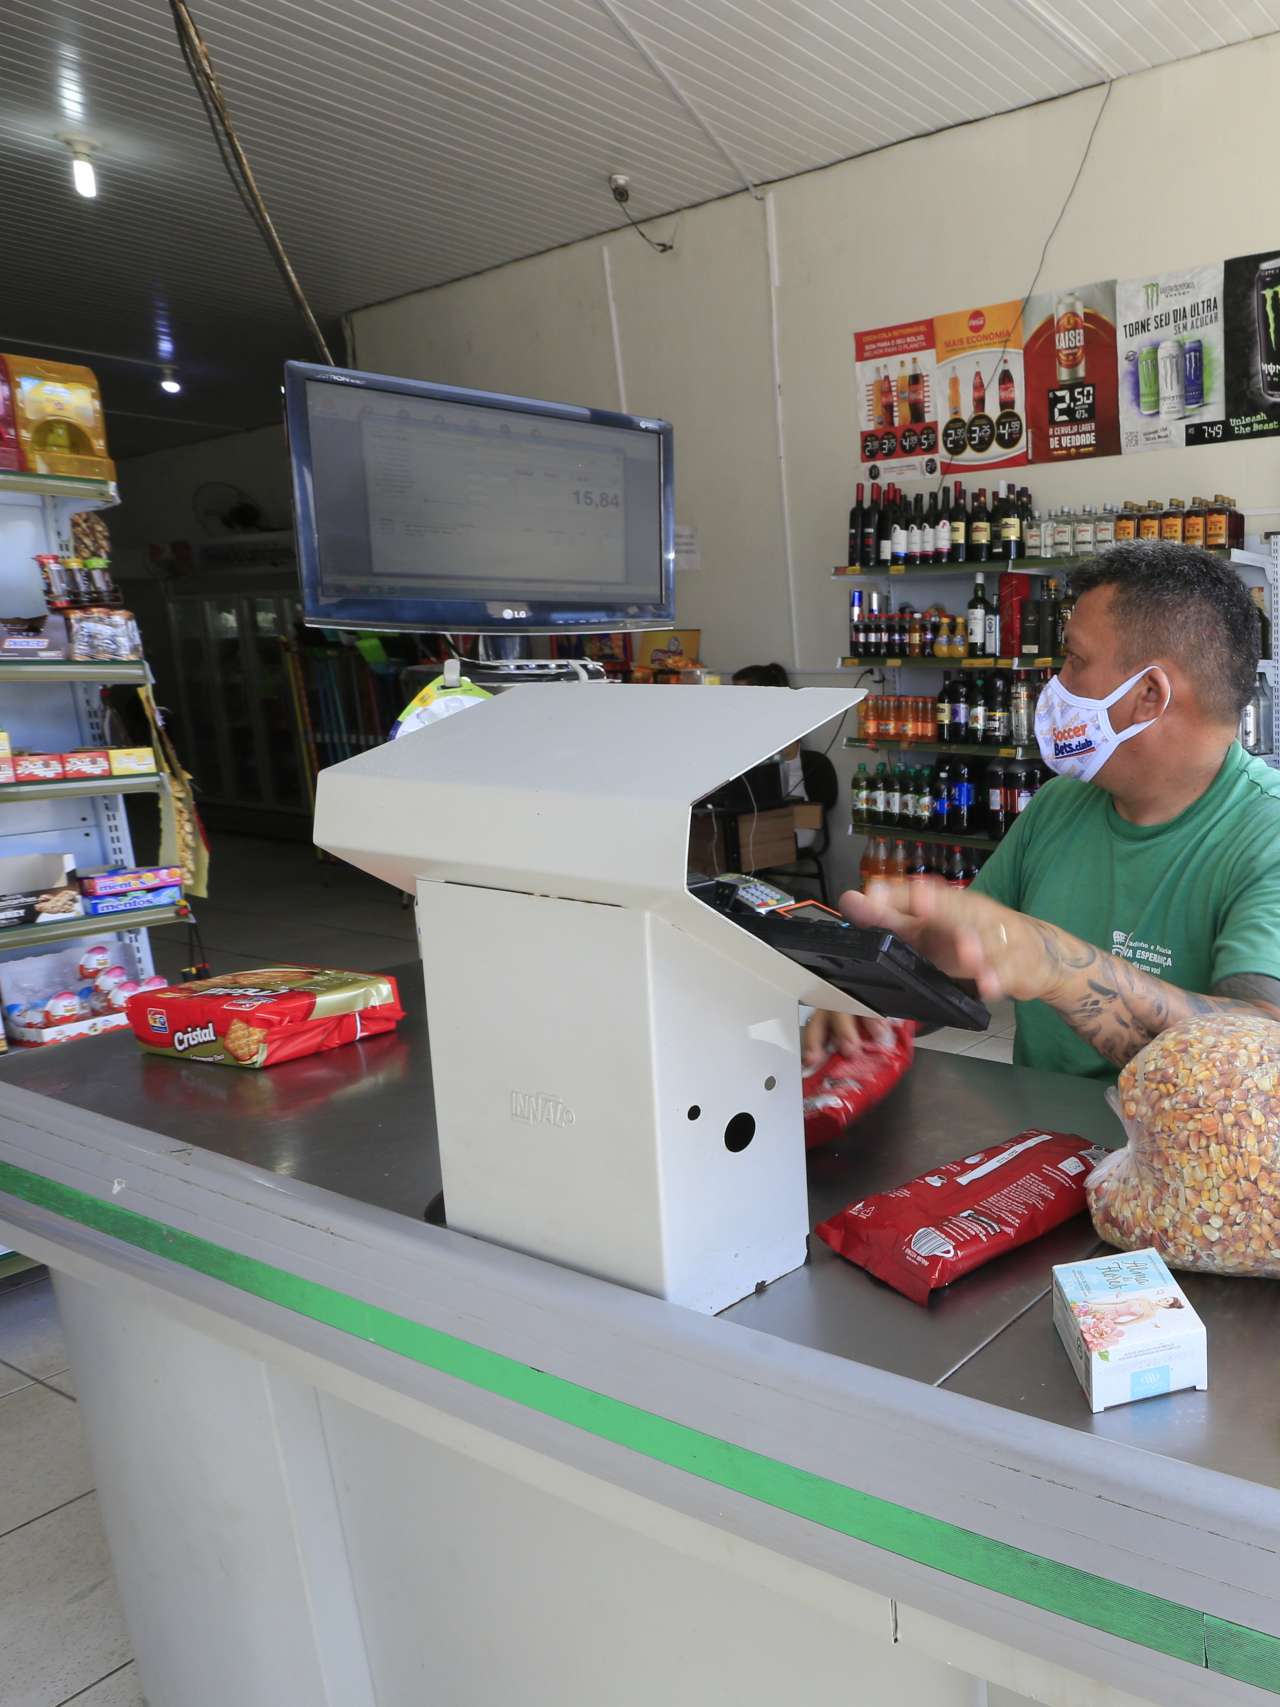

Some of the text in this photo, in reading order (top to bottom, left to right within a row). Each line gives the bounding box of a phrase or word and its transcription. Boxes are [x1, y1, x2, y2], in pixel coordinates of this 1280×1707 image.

[1123, 296, 1218, 339] TORNE SEU DIA ULTRA
[1173, 321, 1188, 335] SEM
[944, 337, 964, 348] MAIS
[966, 329, 1012, 345] ECONOMIA
[1229, 412, 1267, 427] Unleash
[1054, 424, 1078, 435] CERVEJA
[1079, 422, 1096, 432] LAGER
[1234, 422, 1251, 434] the
[1049, 433, 1097, 449] DE VERDADE
[572, 489, 620, 509] 15,84
[514, 610, 527, 619] LG
[1052, 723, 1088, 742] Soccer
[101, 897, 154, 912] mentos
[174, 1023, 217, 1050] Cristal
[1096, 1261, 1128, 1290] Flores
